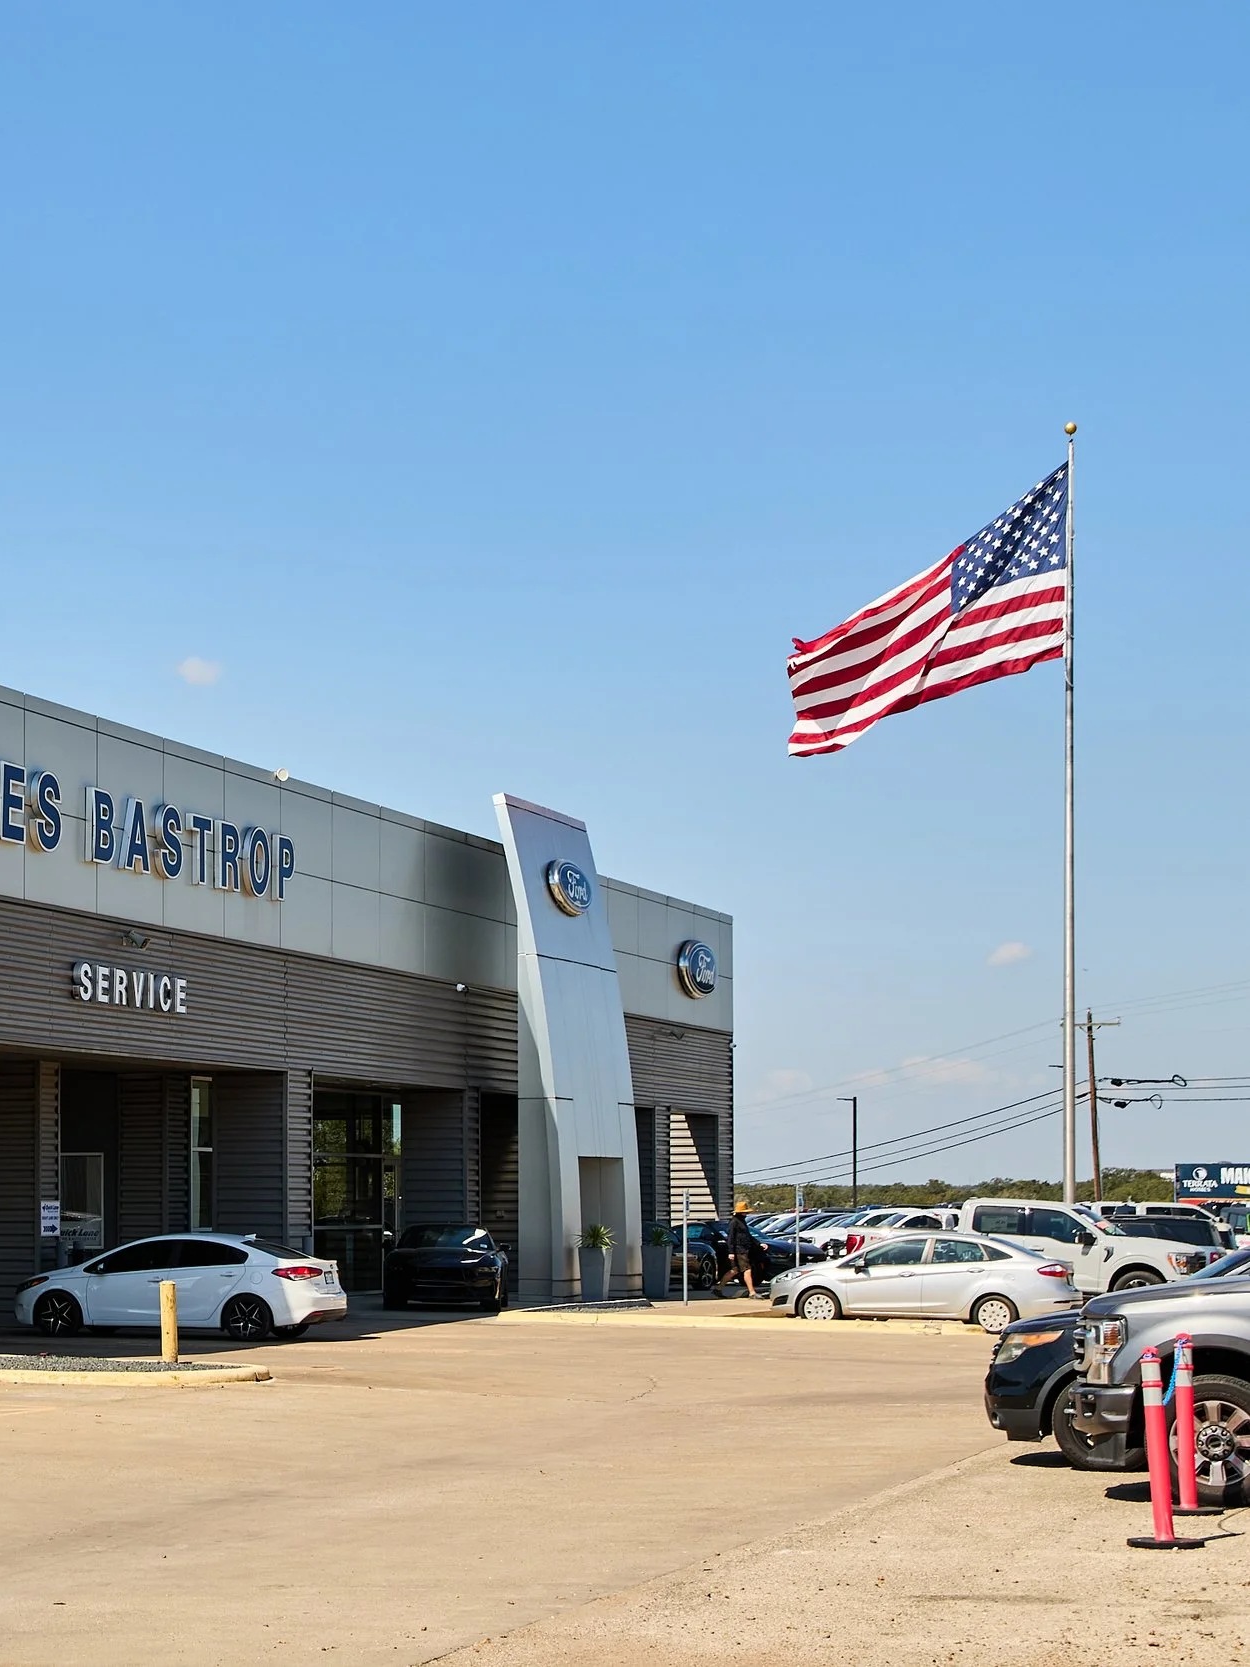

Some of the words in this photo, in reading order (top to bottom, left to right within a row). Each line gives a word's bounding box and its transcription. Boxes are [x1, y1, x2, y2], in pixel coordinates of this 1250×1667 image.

[85, 786, 296, 901] BASTROP
[73, 961, 188, 1014] SERVICE
[1182, 1180, 1219, 1188] TERRATA
[59, 1229, 77, 1237] uick
[78, 1229, 100, 1237] Lane
